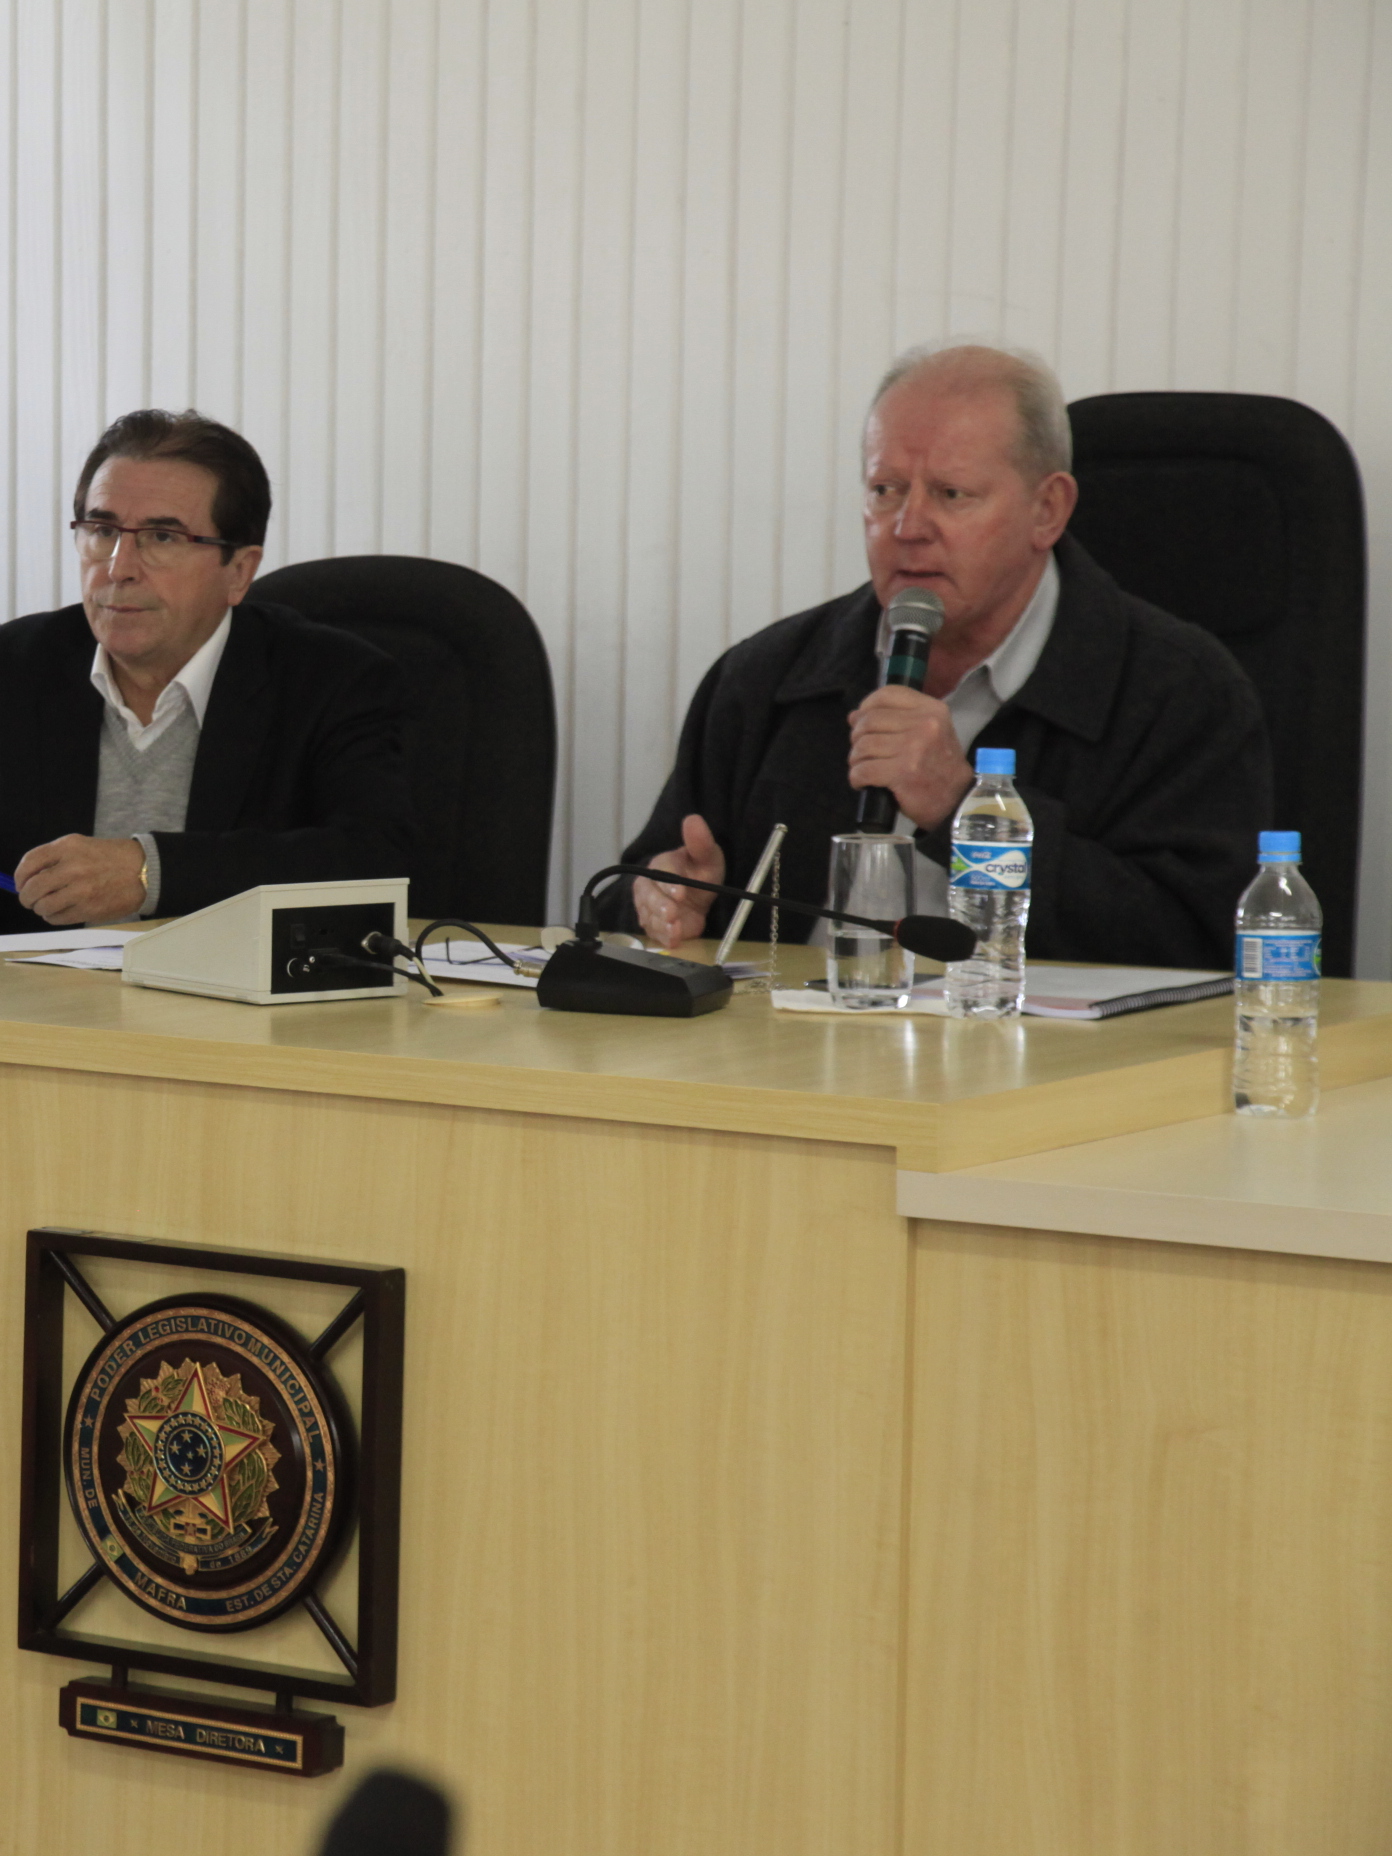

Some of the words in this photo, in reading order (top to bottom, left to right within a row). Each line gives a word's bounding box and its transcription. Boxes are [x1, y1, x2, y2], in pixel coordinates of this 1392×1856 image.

[985, 862, 1027, 875] crystal
[90, 1340, 136, 1401] PODER
[137, 1317, 246, 1344] LEGISLATIVO
[248, 1338, 320, 1443] MUNICIPAL
[81, 1447, 92, 1485] MUN.
[85, 1488, 98, 1509] DE
[225, 1596, 254, 1612] EST.
[253, 1584, 272, 1601] DE
[271, 1565, 297, 1588] STA.
[293, 1492, 324, 1563] CATARINA
[134, 1571, 187, 1610] MAFRA
[146, 1719, 185, 1740] MESA
[196, 1728, 266, 1753] DIRETORA
